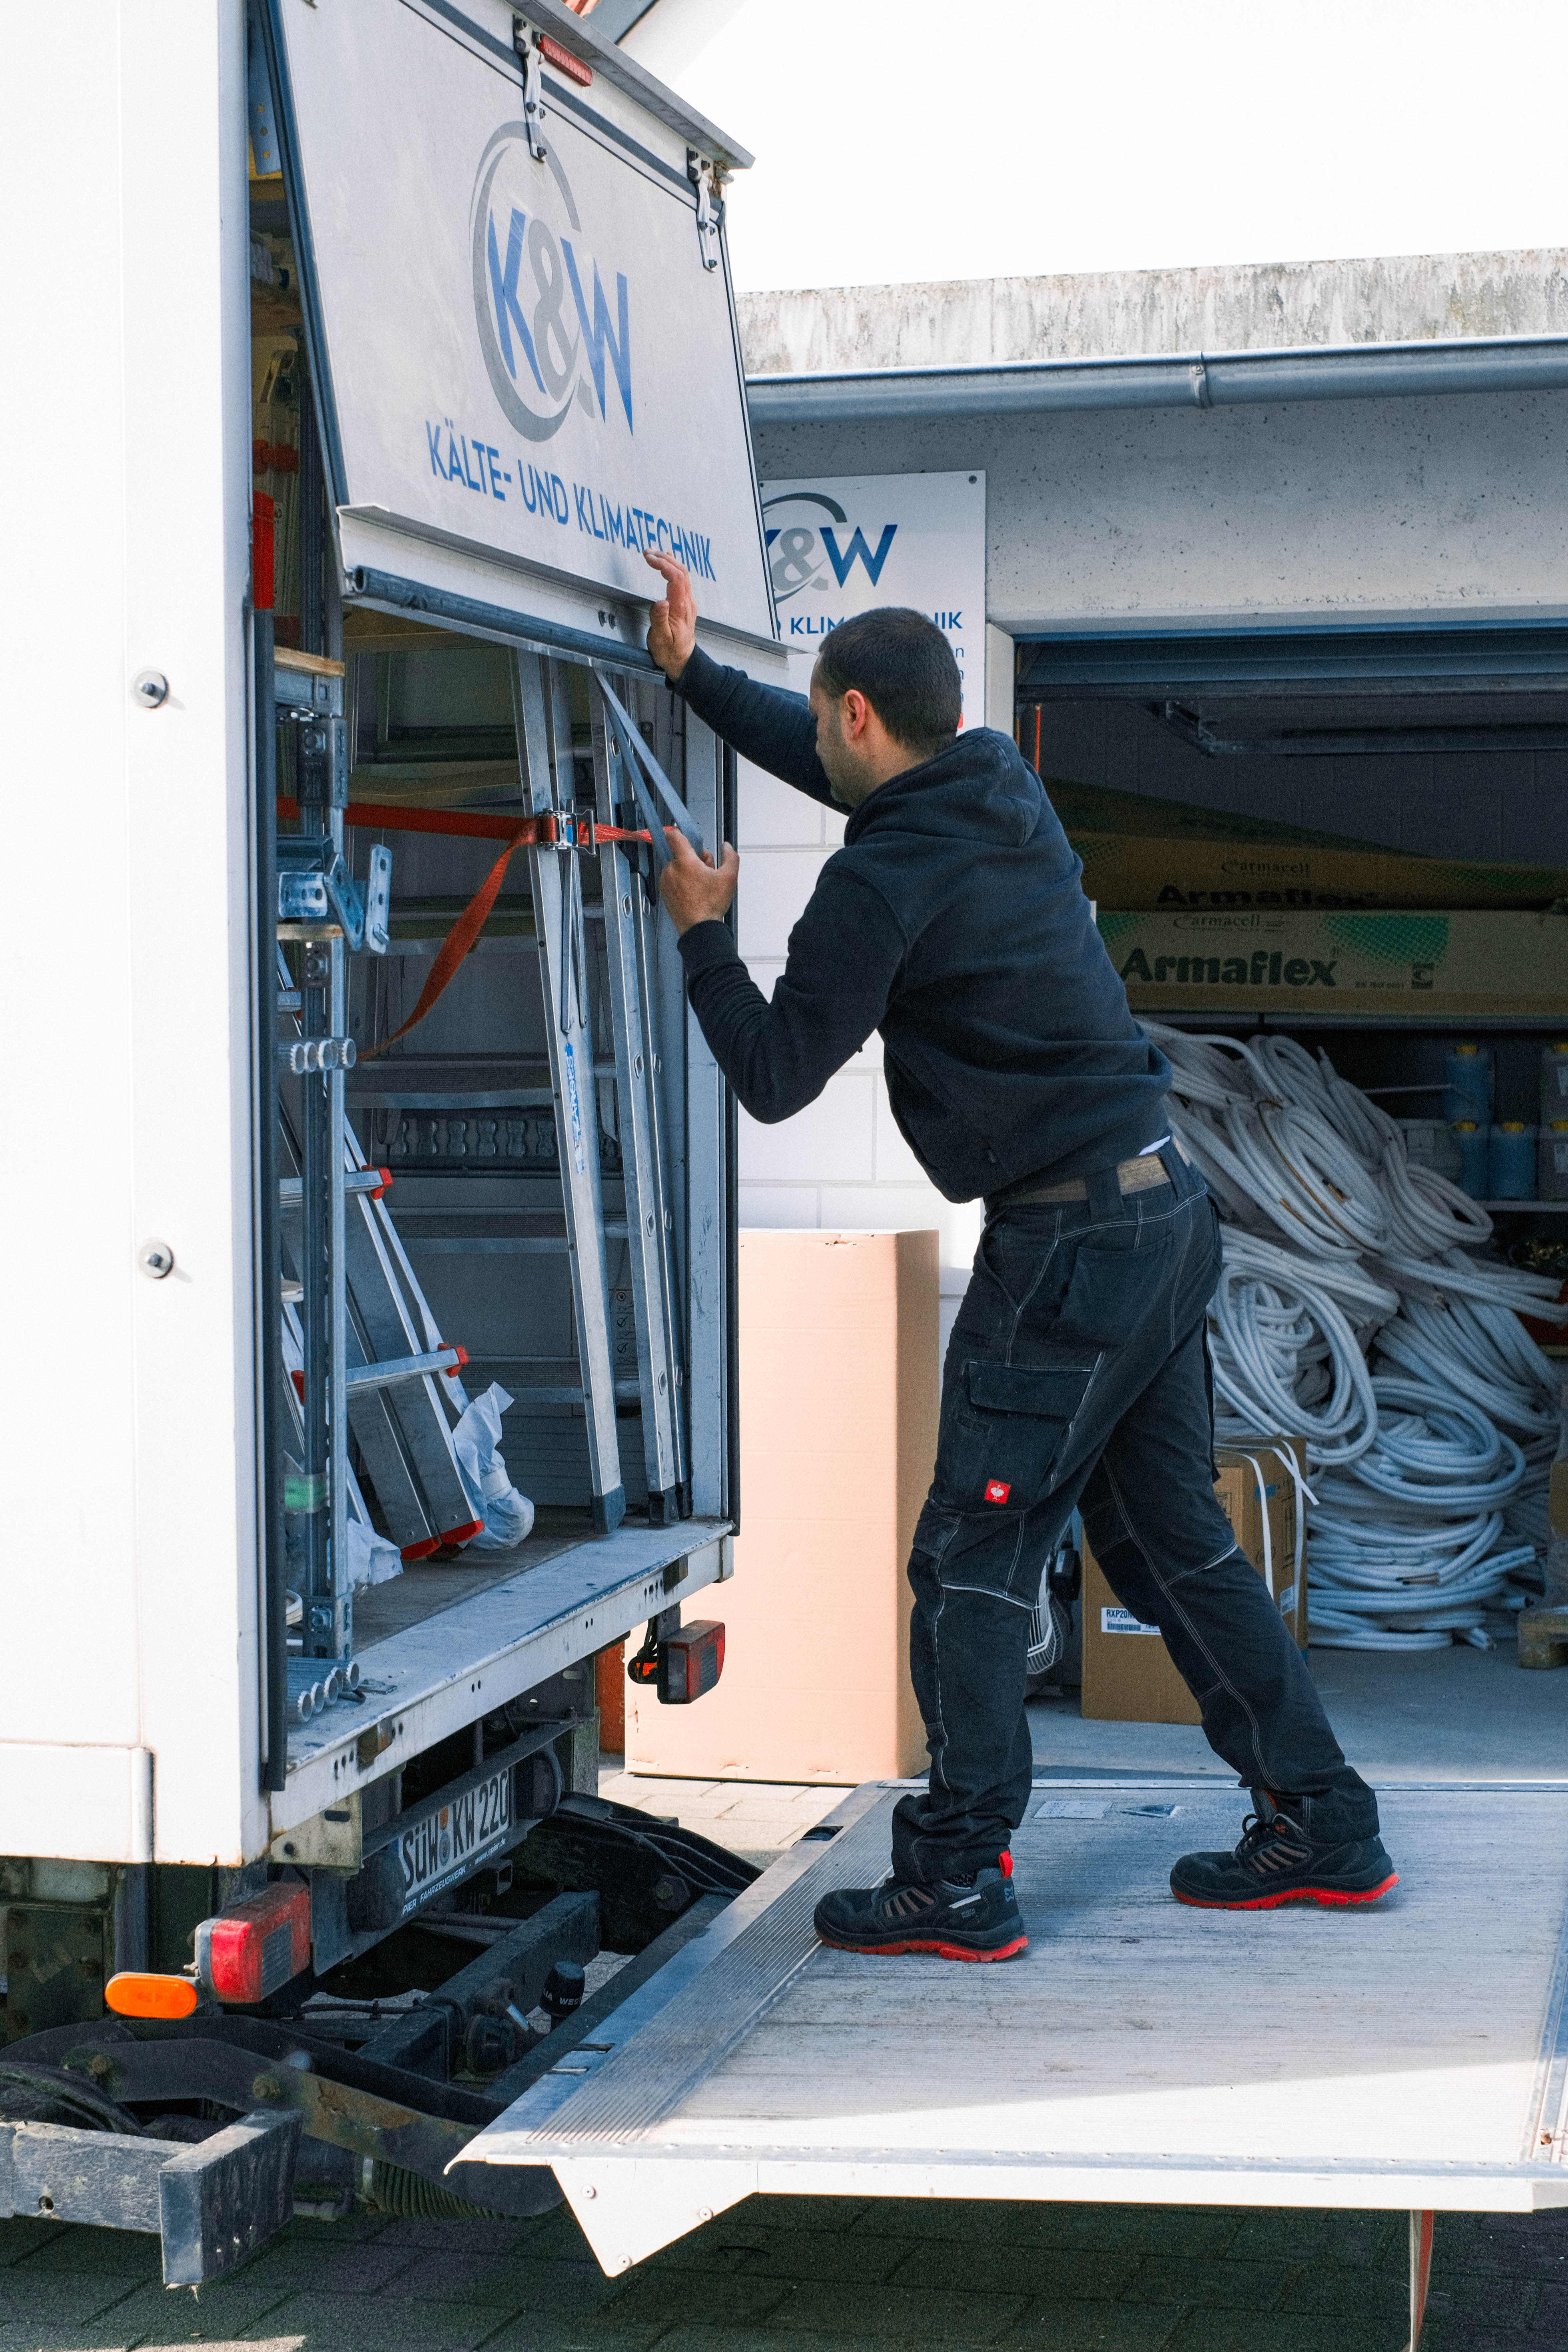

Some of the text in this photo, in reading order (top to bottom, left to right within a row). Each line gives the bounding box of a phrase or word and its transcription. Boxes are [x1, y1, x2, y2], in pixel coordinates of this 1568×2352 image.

[487, 206, 634, 437] K&W
[425, 417, 717, 582] KÄLTE- UND KLIMATECHNIK
[765, 524, 898, 592] &W
[1120, 947, 1338, 987] Armaflex
[401, 1837, 506, 1916] PIER FAHRZEUGWERK www.spier.de
[402, 1769, 508, 1892] SÜW KW 220
